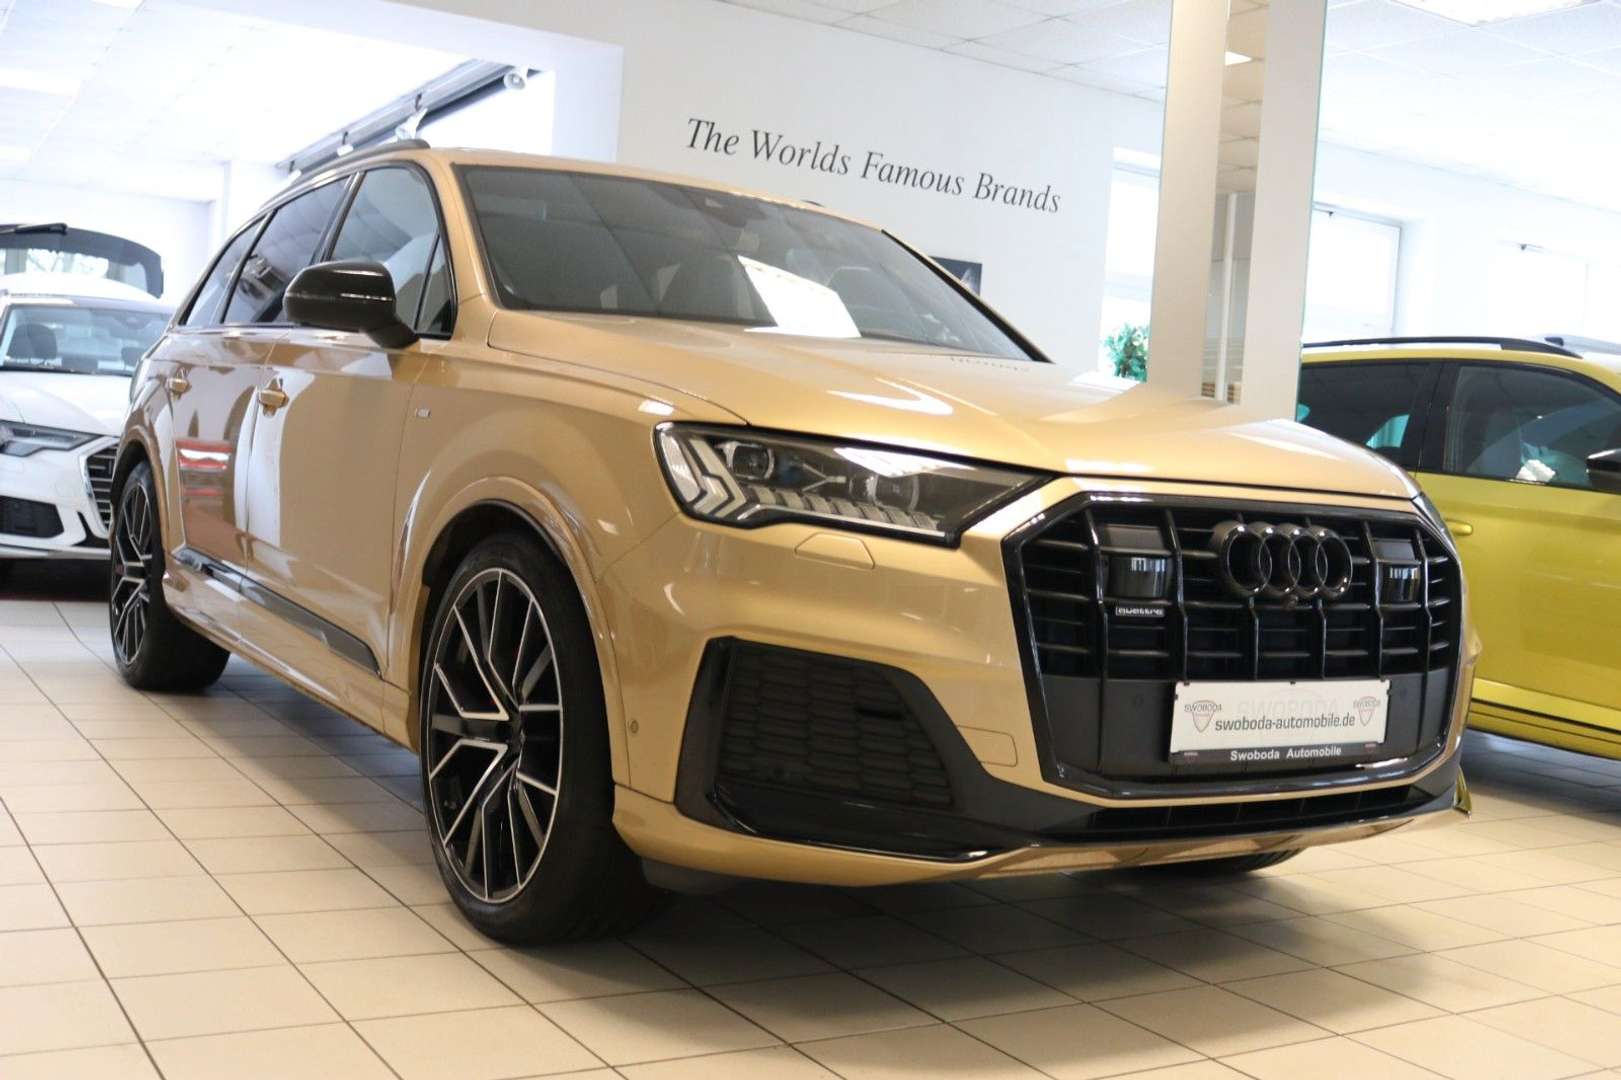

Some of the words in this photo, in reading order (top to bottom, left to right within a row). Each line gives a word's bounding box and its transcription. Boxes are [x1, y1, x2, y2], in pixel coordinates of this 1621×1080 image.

[687, 117, 740, 156] The
[751, 129, 852, 176] Worlds
[860, 150, 966, 197] Famous
[973, 171, 1062, 214] Brands
[1215, 712, 1356, 732] swoboda-automobile.de
[1230, 748, 1280, 761] Swoboda
[1286, 745, 1342, 759] Automobile
